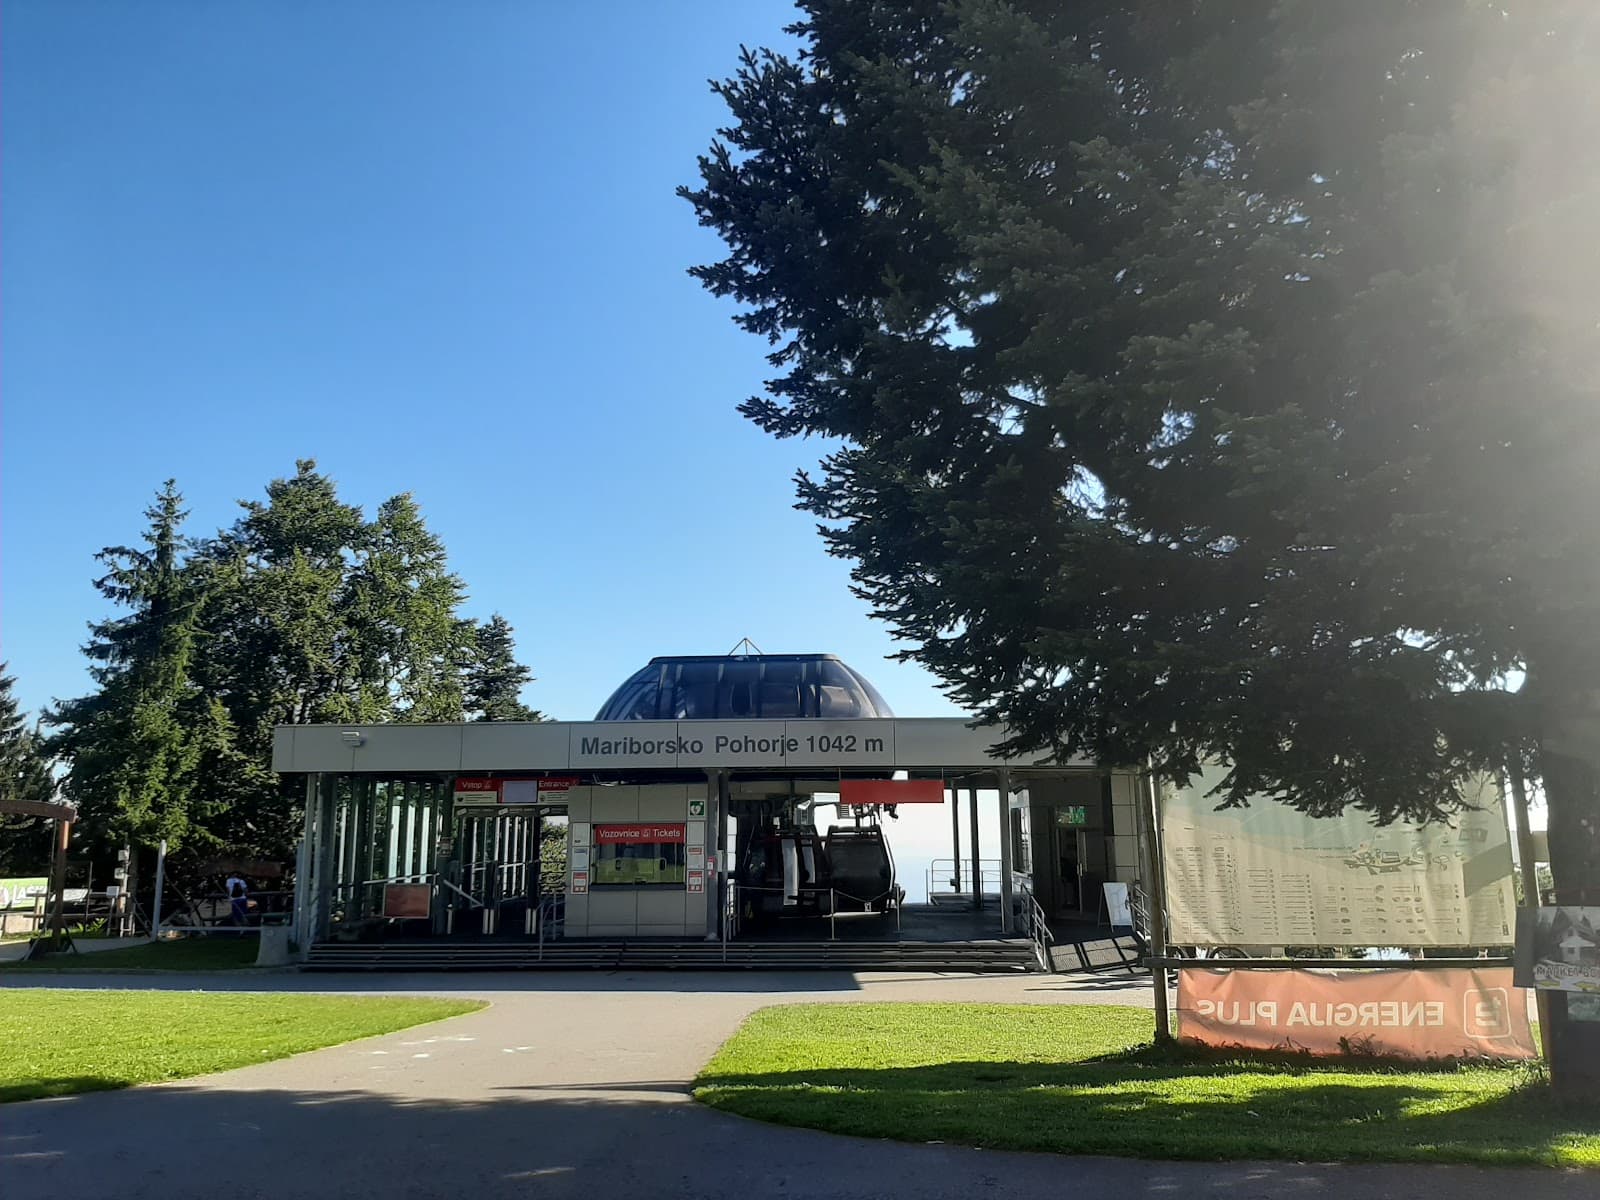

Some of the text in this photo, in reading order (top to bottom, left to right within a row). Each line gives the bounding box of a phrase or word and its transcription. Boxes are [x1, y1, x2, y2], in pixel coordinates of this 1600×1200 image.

[581, 735, 883, 757] Mariborsko Pohorje 1042 m
[539, 780, 569, 788] Entrance
[599, 829, 680, 839] Vozovnice Tickets
